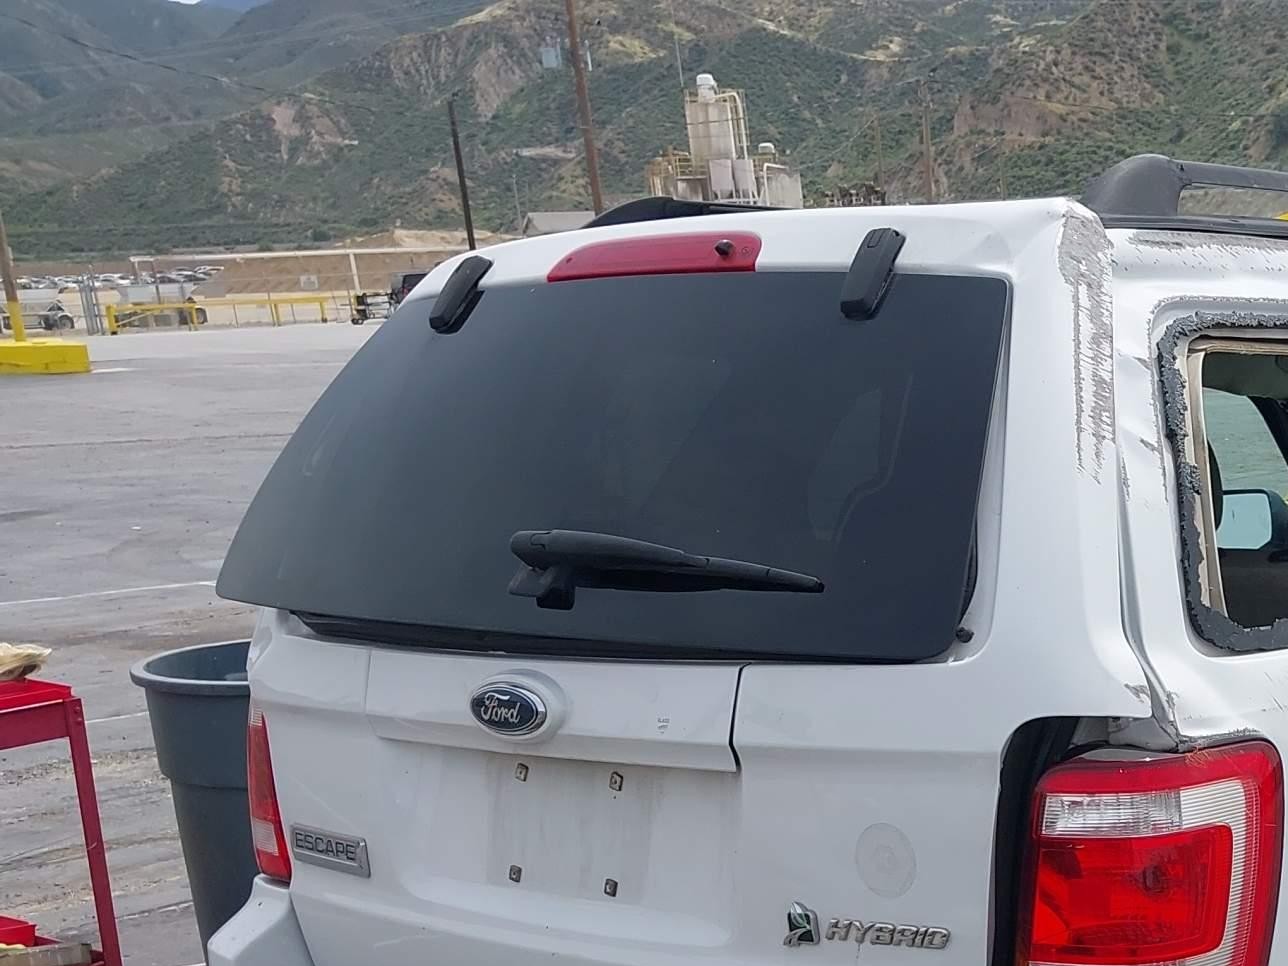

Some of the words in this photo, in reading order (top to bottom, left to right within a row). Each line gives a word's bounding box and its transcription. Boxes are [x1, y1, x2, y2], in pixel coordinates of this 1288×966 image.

[481, 692, 520, 723] Ford
[295, 831, 356, 861] ESCAPE
[825, 917, 951, 950] HYBRID
